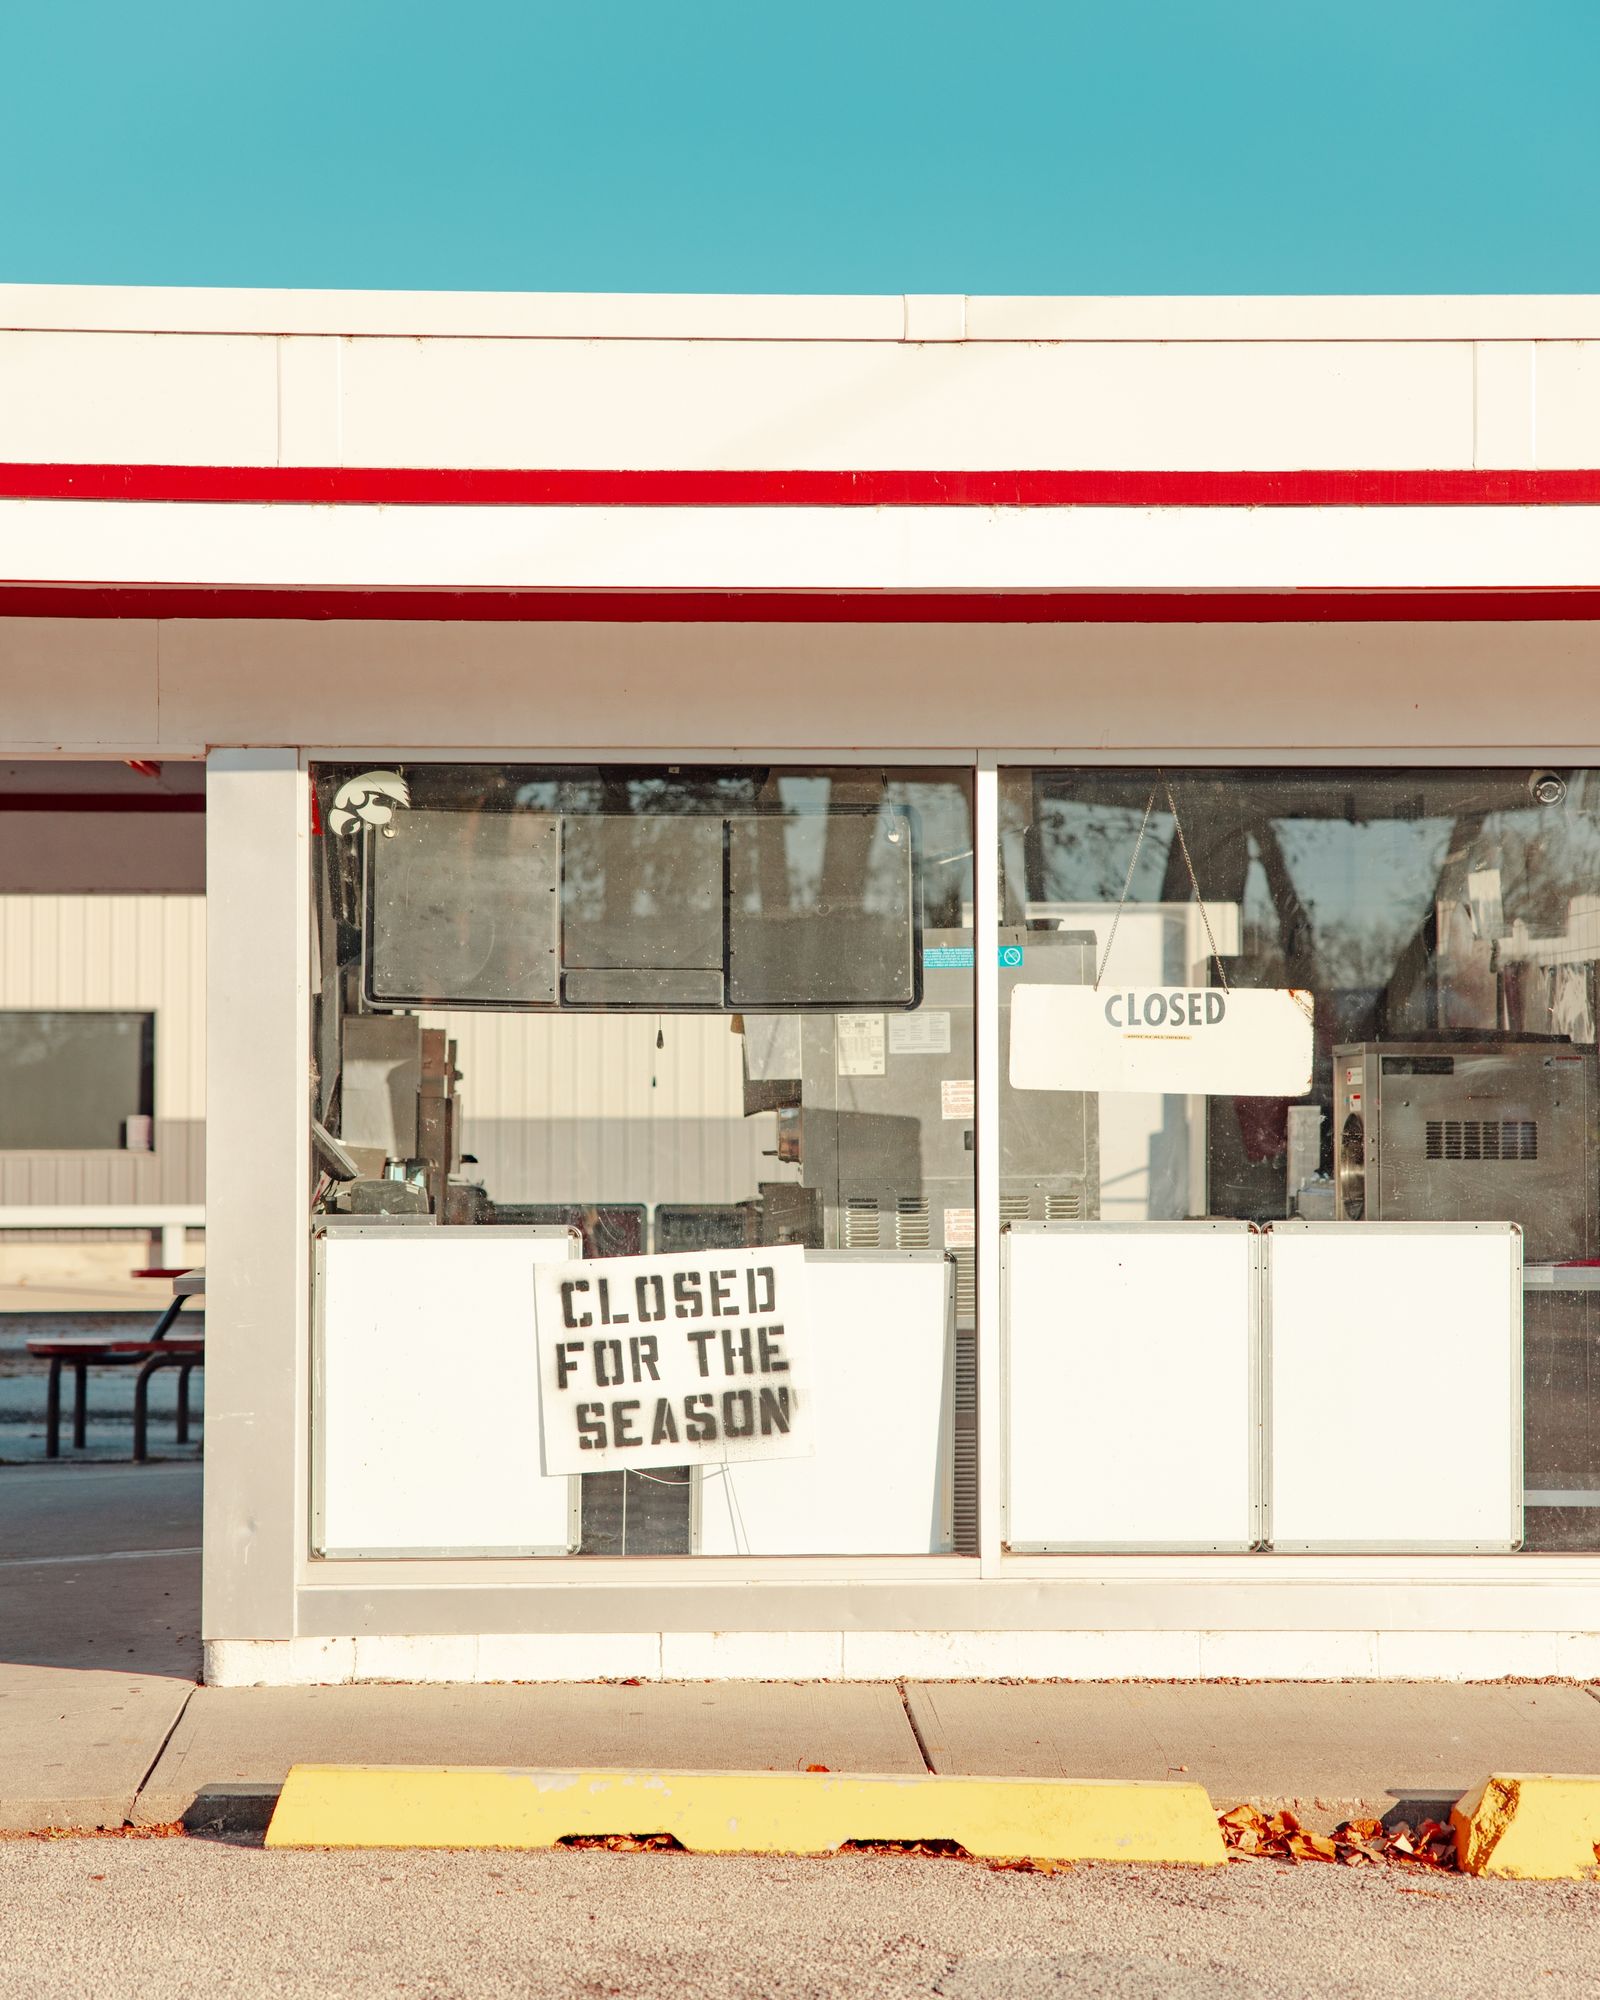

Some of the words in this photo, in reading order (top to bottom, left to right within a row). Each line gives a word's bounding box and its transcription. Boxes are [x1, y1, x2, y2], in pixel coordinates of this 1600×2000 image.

[1104, 992, 1226, 1028] CLOSED
[560, 1266, 776, 1329] CLOSED
[555, 1335, 661, 1389] FOR
[687, 1325, 790, 1377] THE
[575, 1386, 790, 1450] SEASON
